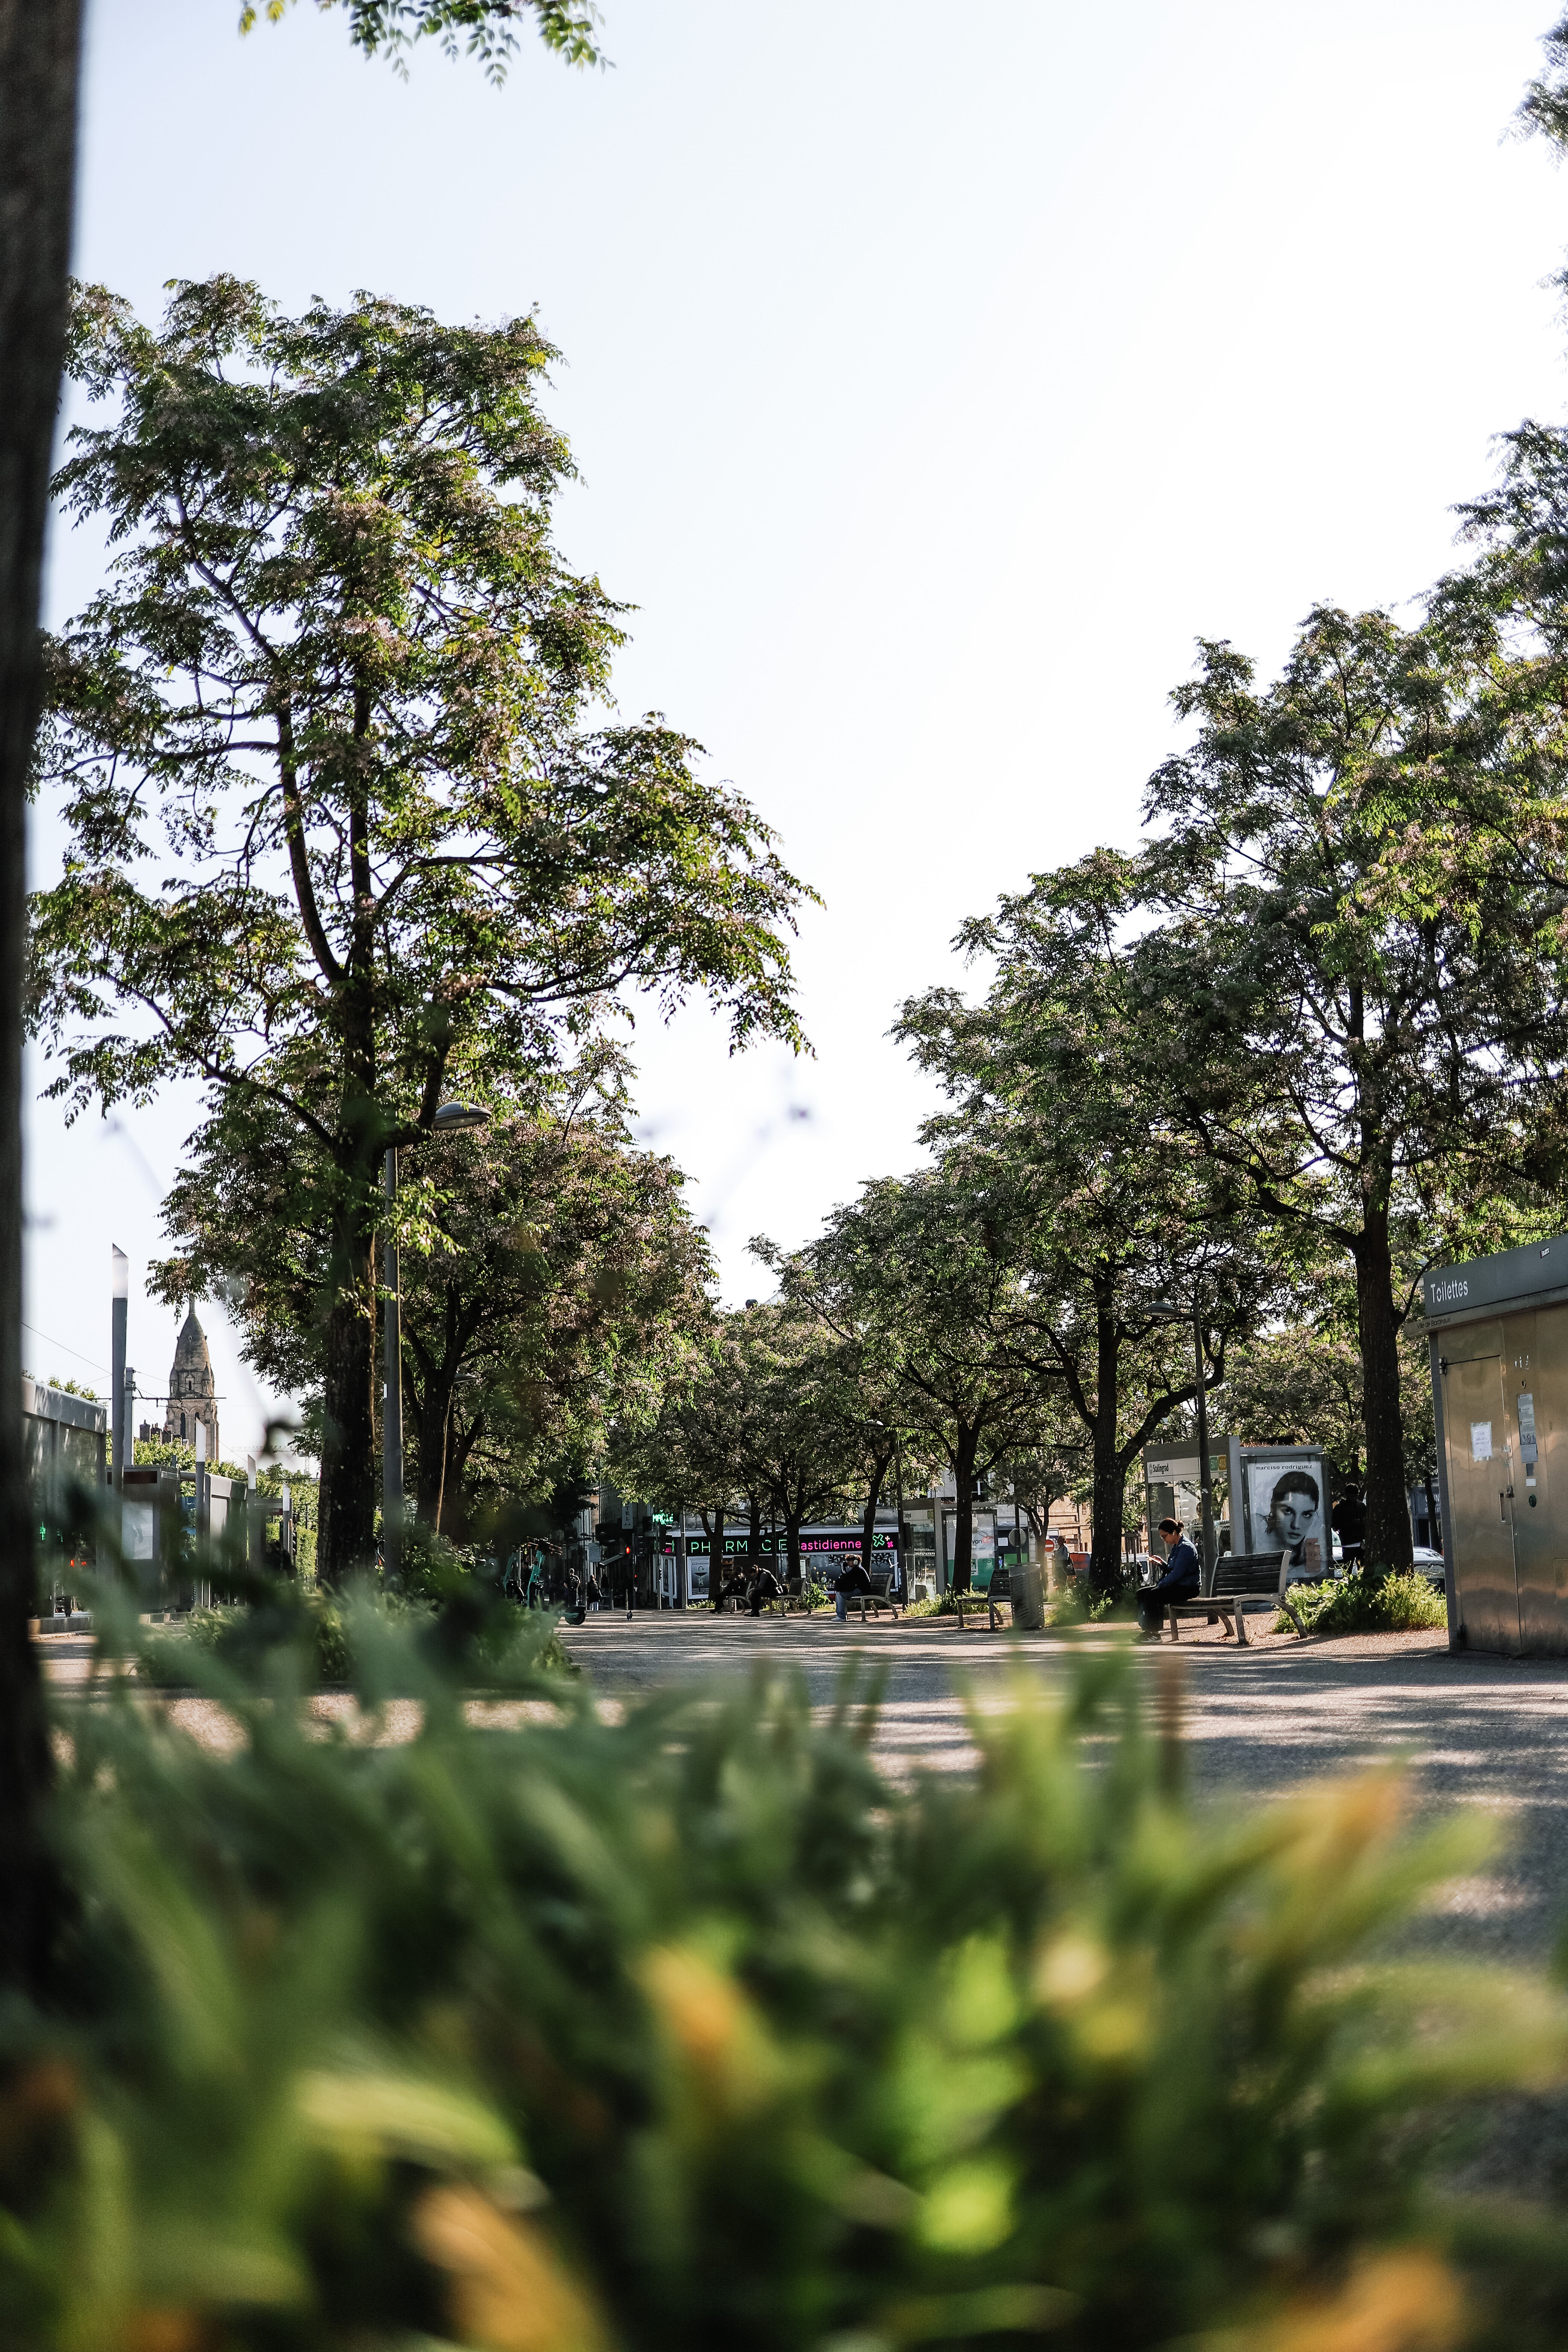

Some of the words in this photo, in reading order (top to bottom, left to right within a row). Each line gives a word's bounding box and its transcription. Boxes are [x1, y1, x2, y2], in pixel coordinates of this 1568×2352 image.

[1430, 1279, 1468, 1303] Toilettes
[1153, 1462, 1169, 1475] Stalingrad
[691, 1539, 787, 1553] PHRMCE
[801, 1539, 862, 1551] astidienne
